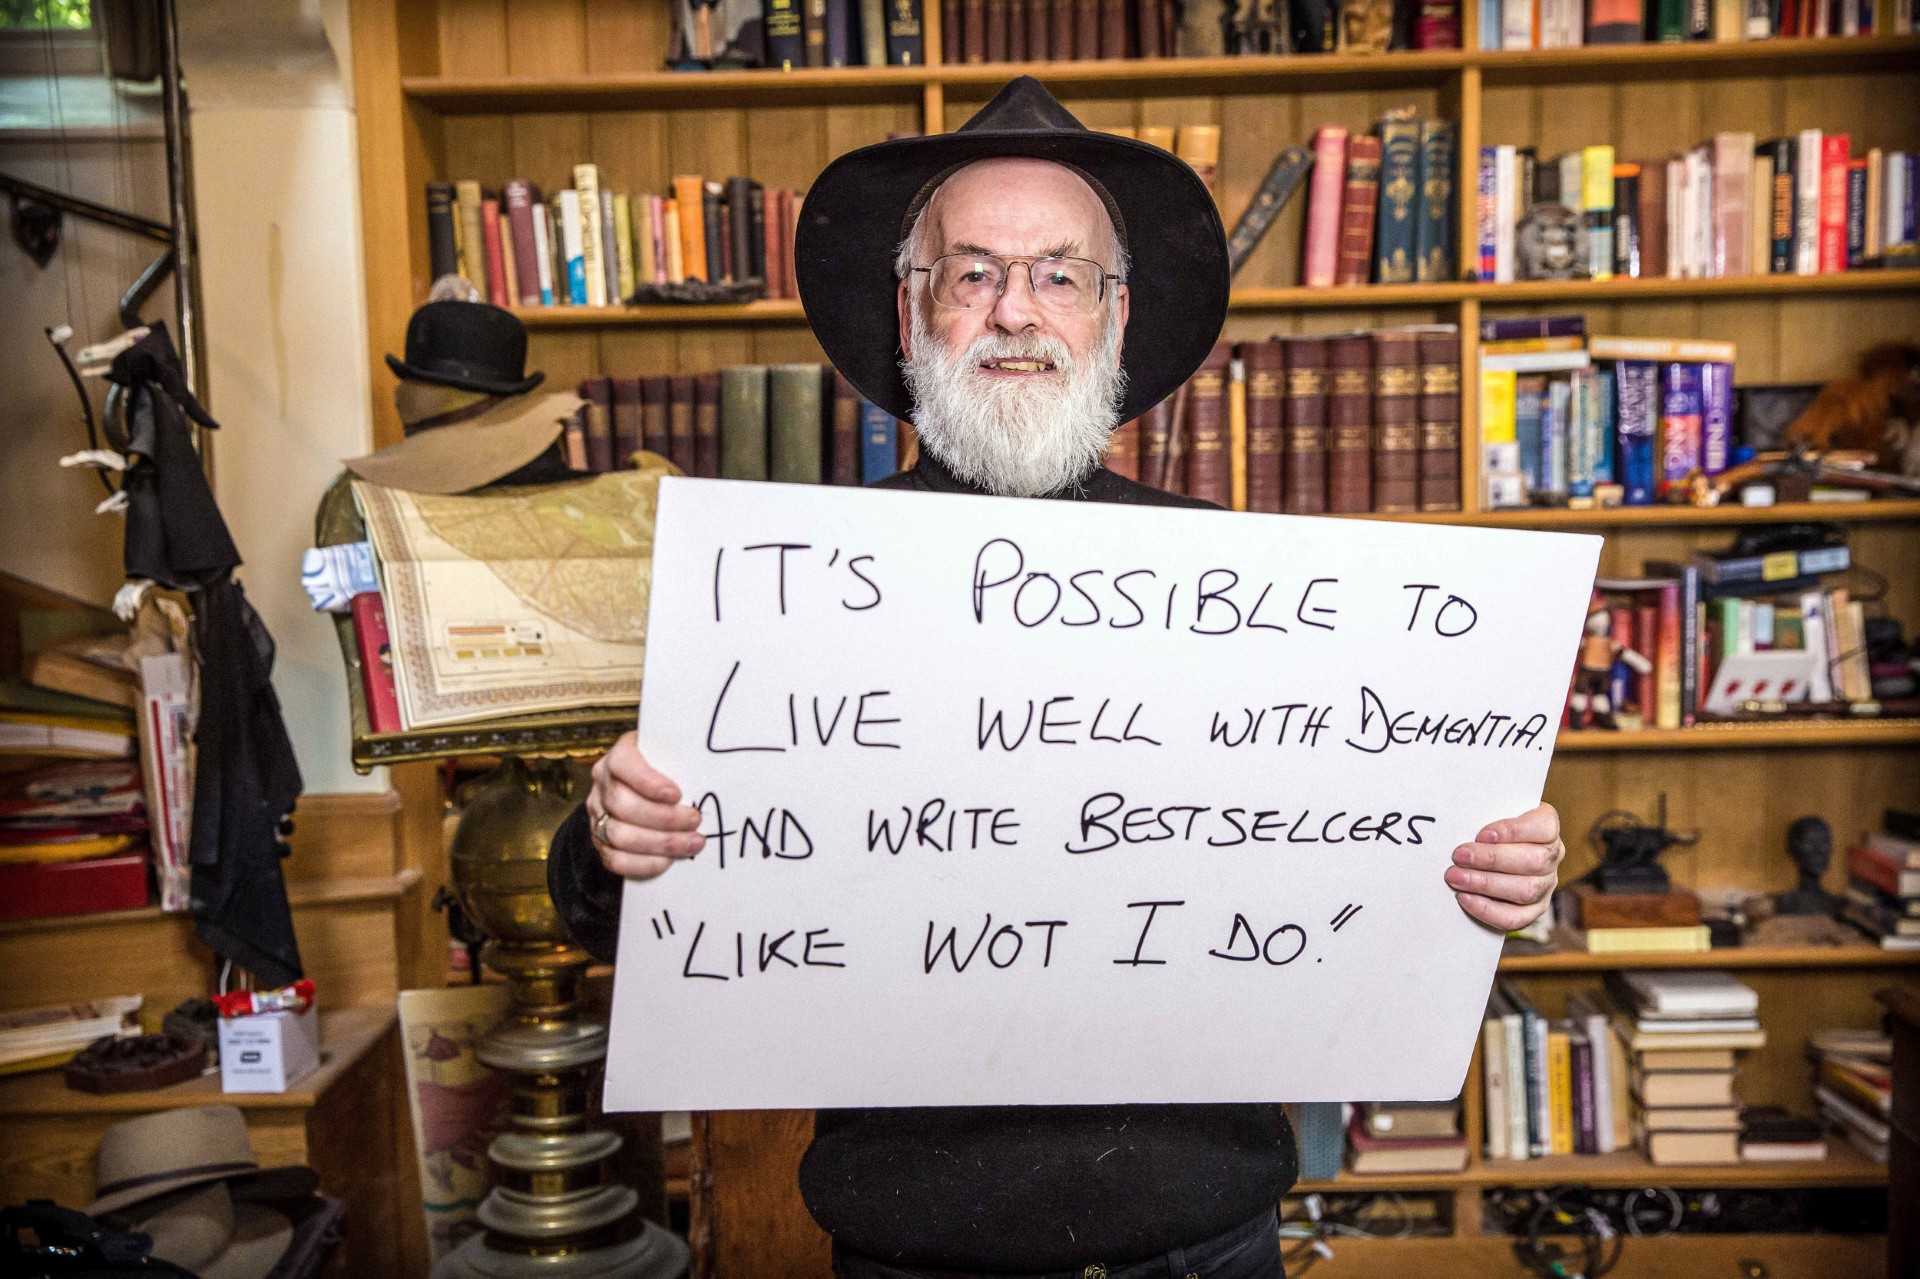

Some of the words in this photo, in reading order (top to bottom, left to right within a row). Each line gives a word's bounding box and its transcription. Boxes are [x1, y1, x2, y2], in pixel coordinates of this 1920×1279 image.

[713, 543, 881, 623] IT'S
[973, 538, 1339, 636] POSSIBLE
[1403, 584, 1478, 637] TO
[706, 661, 901, 754] LIVE
[978, 697, 1162, 752] WELL
[1210, 703, 1333, 748] WITH
[1344, 685, 1548, 755] DEMENTIA.
[688, 791, 814, 869] AND
[867, 797, 1022, 855] WRITE
[924, 912, 1070, 969] WOT
[1112, 900, 1186, 967] I
